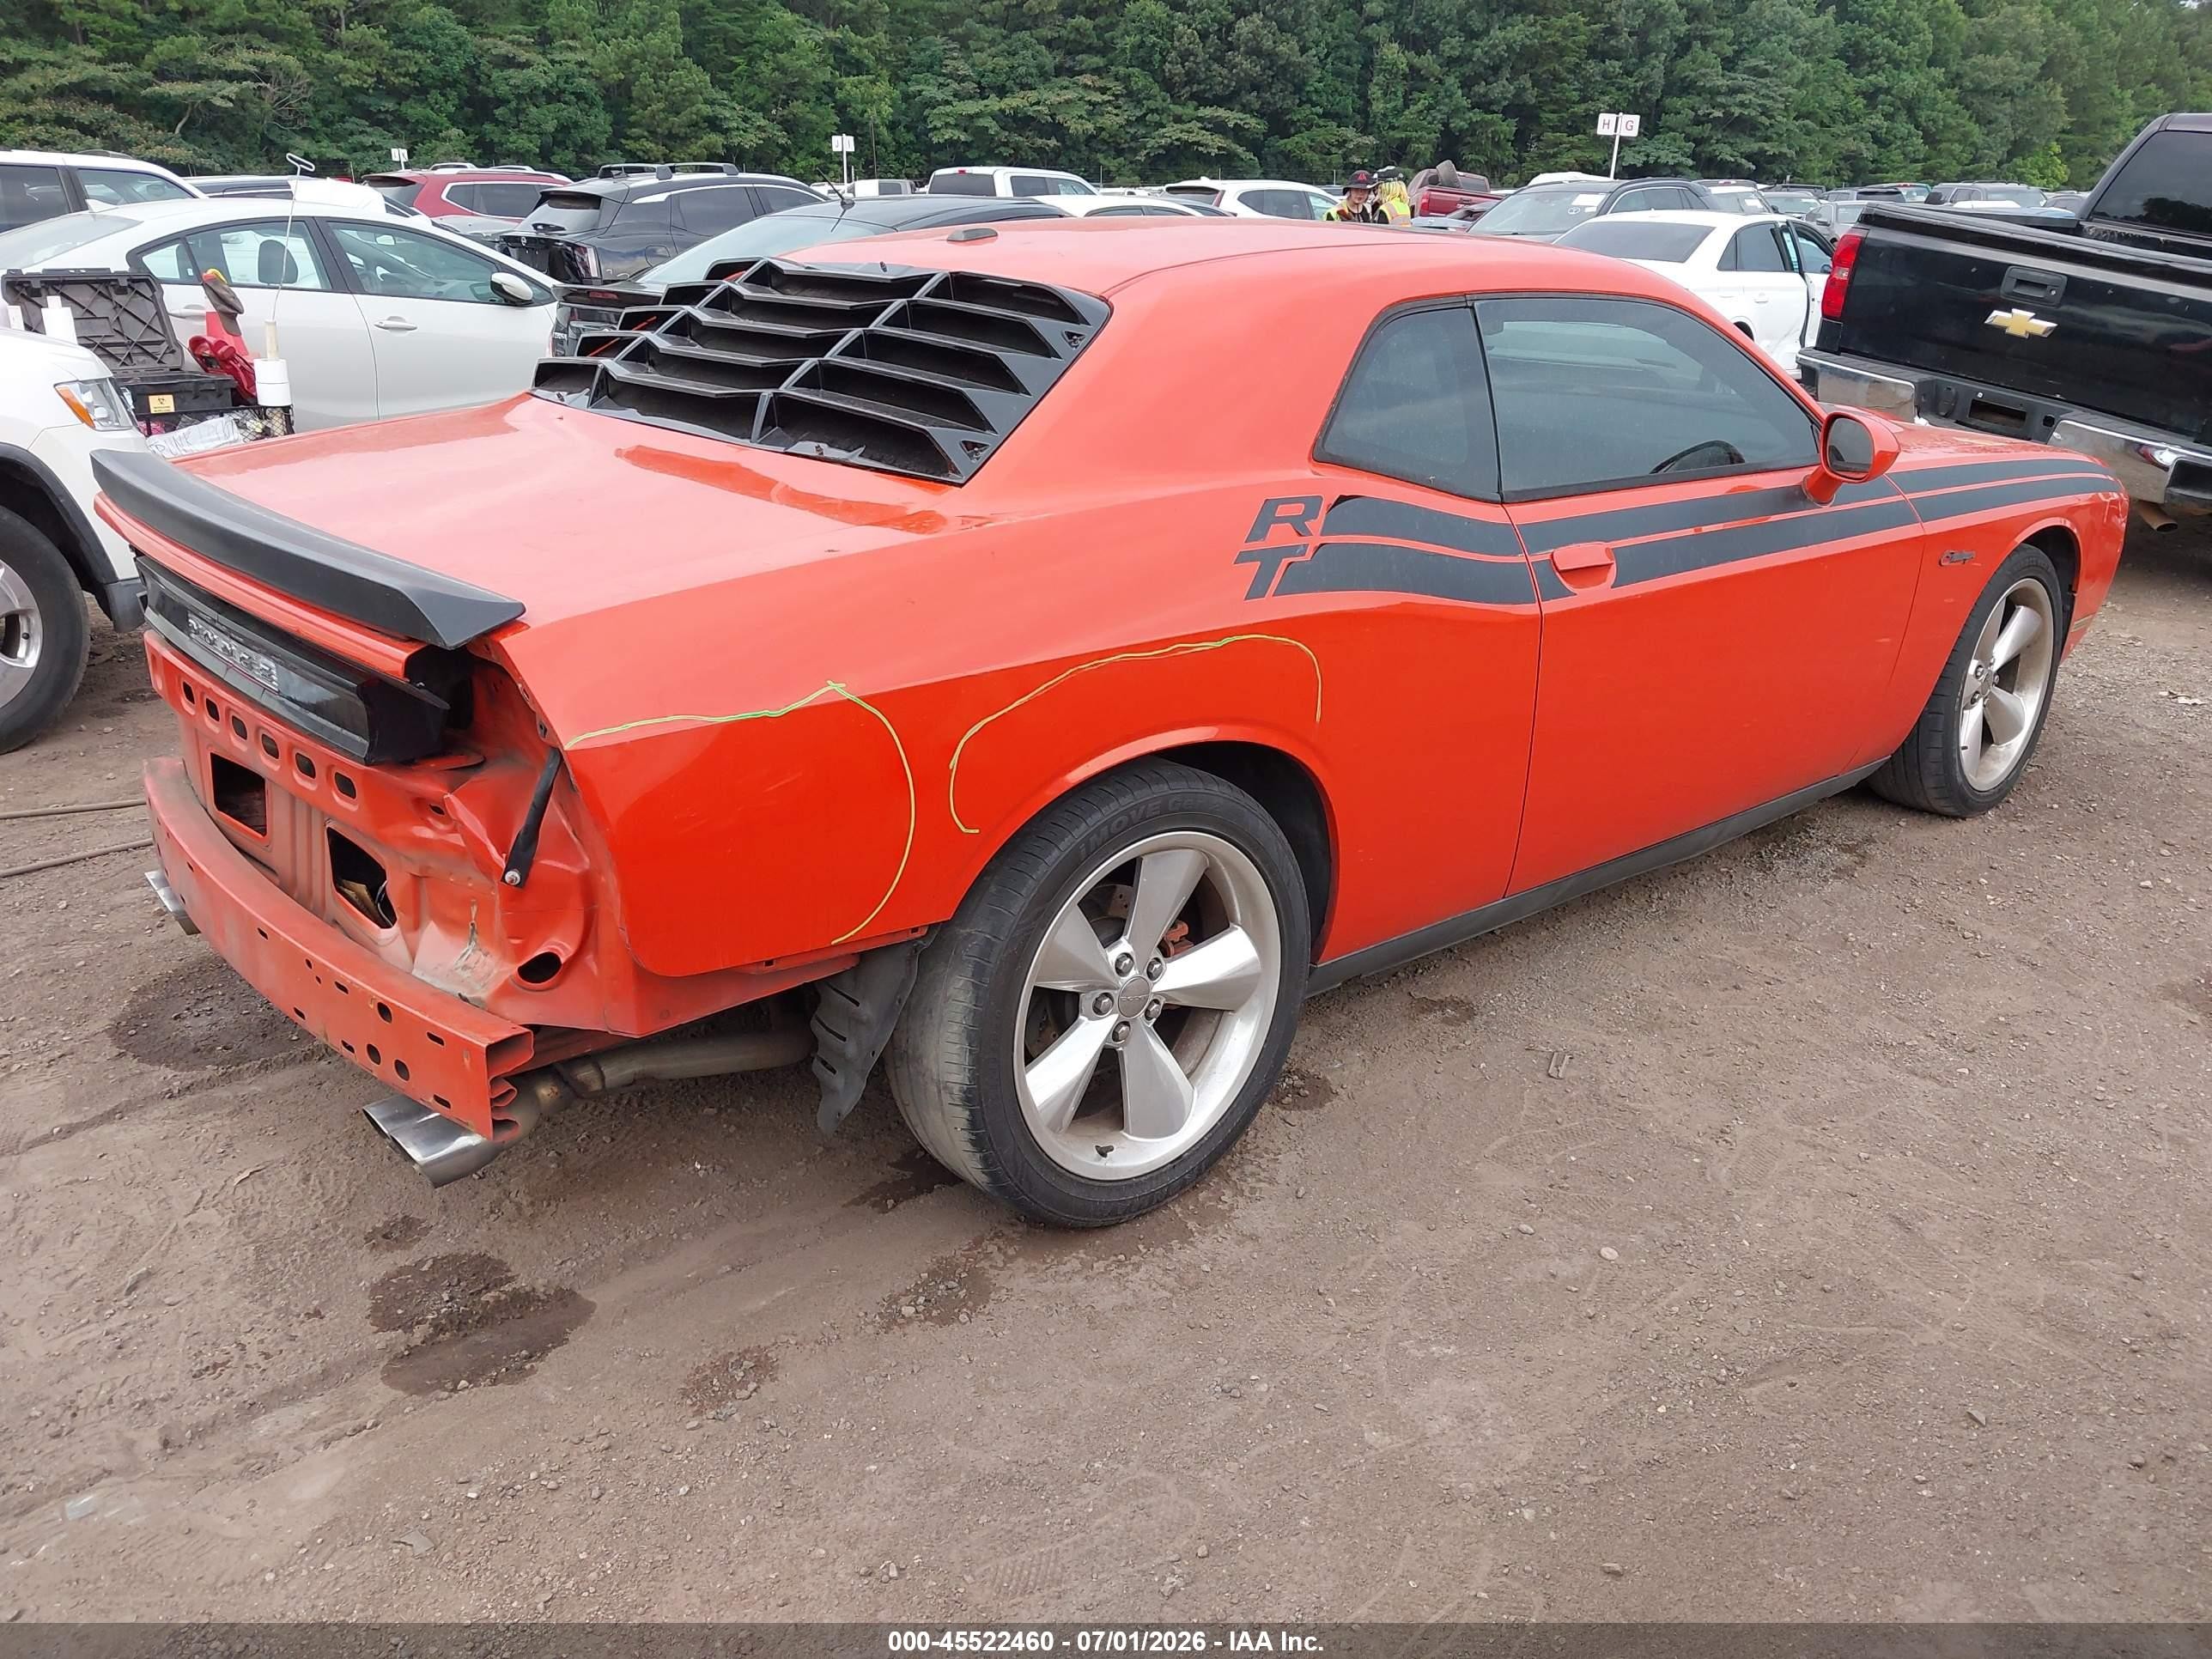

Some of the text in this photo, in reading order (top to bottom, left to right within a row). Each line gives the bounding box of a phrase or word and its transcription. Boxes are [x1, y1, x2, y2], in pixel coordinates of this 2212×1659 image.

[1602, 118, 1610, 130] H
[1626, 120, 1634, 131] G
[1244, 495, 1323, 544] R
[1234, 543, 1309, 601] T
